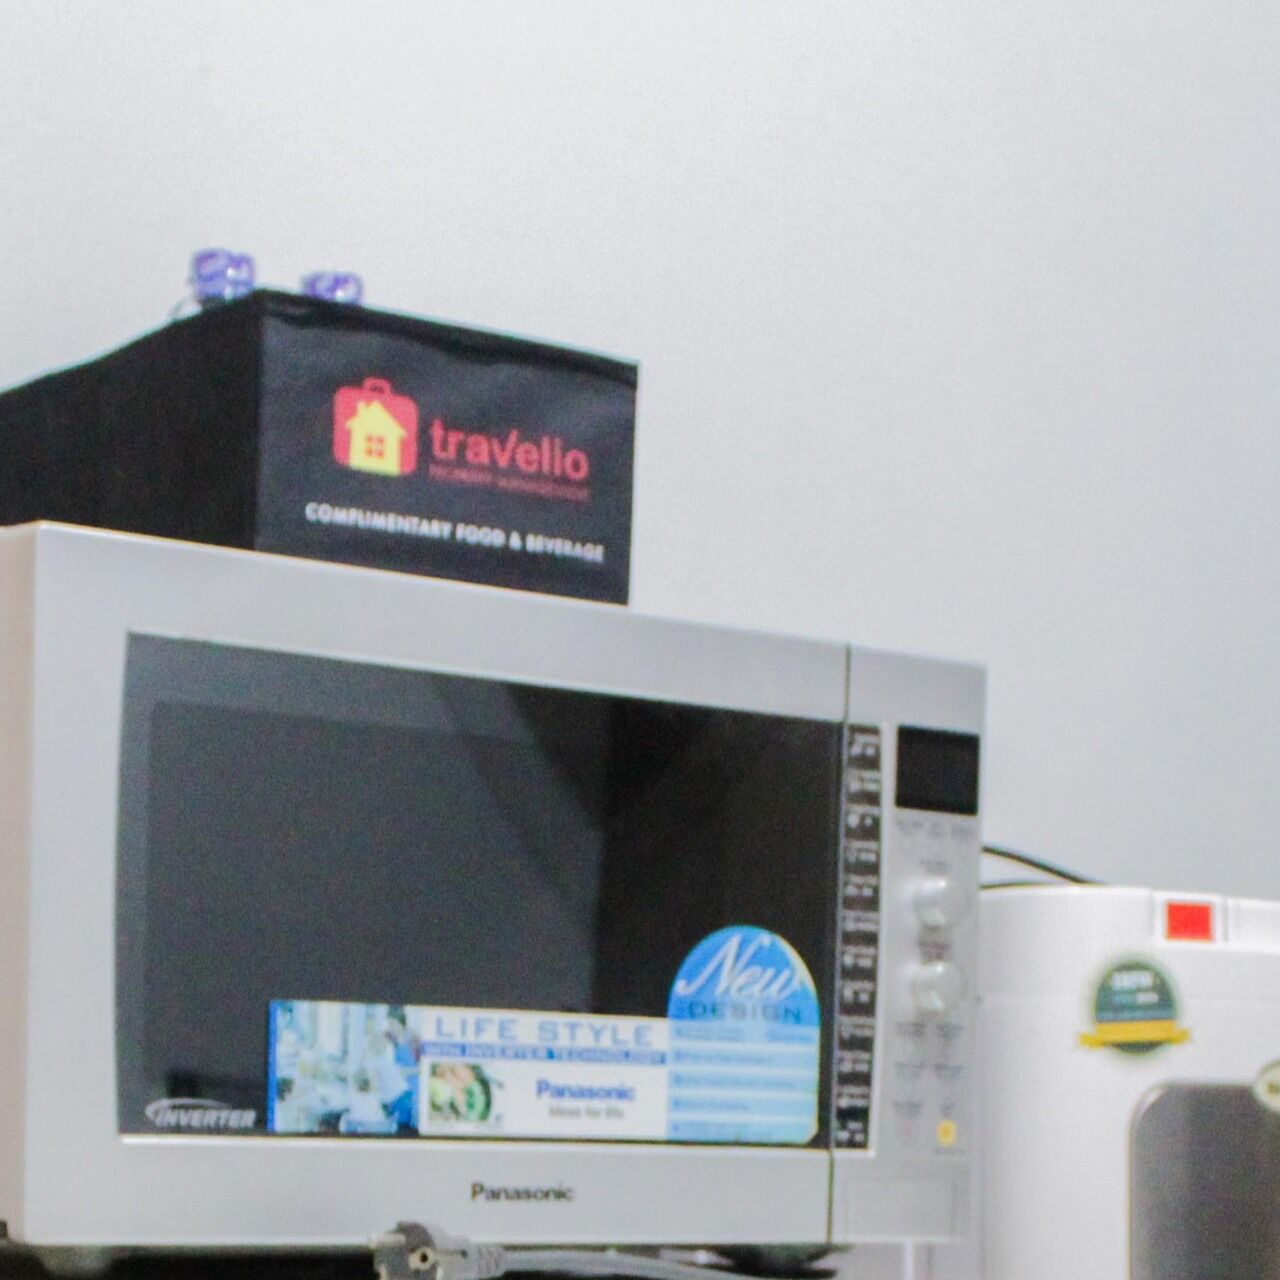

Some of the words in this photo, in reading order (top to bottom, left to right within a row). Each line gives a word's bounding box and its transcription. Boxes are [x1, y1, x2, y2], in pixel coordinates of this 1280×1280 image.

[431, 419, 589, 480] travelio
[305, 502, 453, 541] COMPLIMENTARY
[455, 523, 506, 548] FOOD
[508, 530, 522, 550] &
[525, 534, 605, 563] BEVERAGE
[676, 933, 800, 1001] New
[687, 1001, 802, 1024] DESIGN
[435, 1017, 519, 1041] LIFE
[538, 1022, 652, 1046] STYLE
[536, 1079, 635, 1101] Panasonic
[154, 1108, 256, 1129] INVERTER
[471, 1182, 575, 1202] Panasonic
